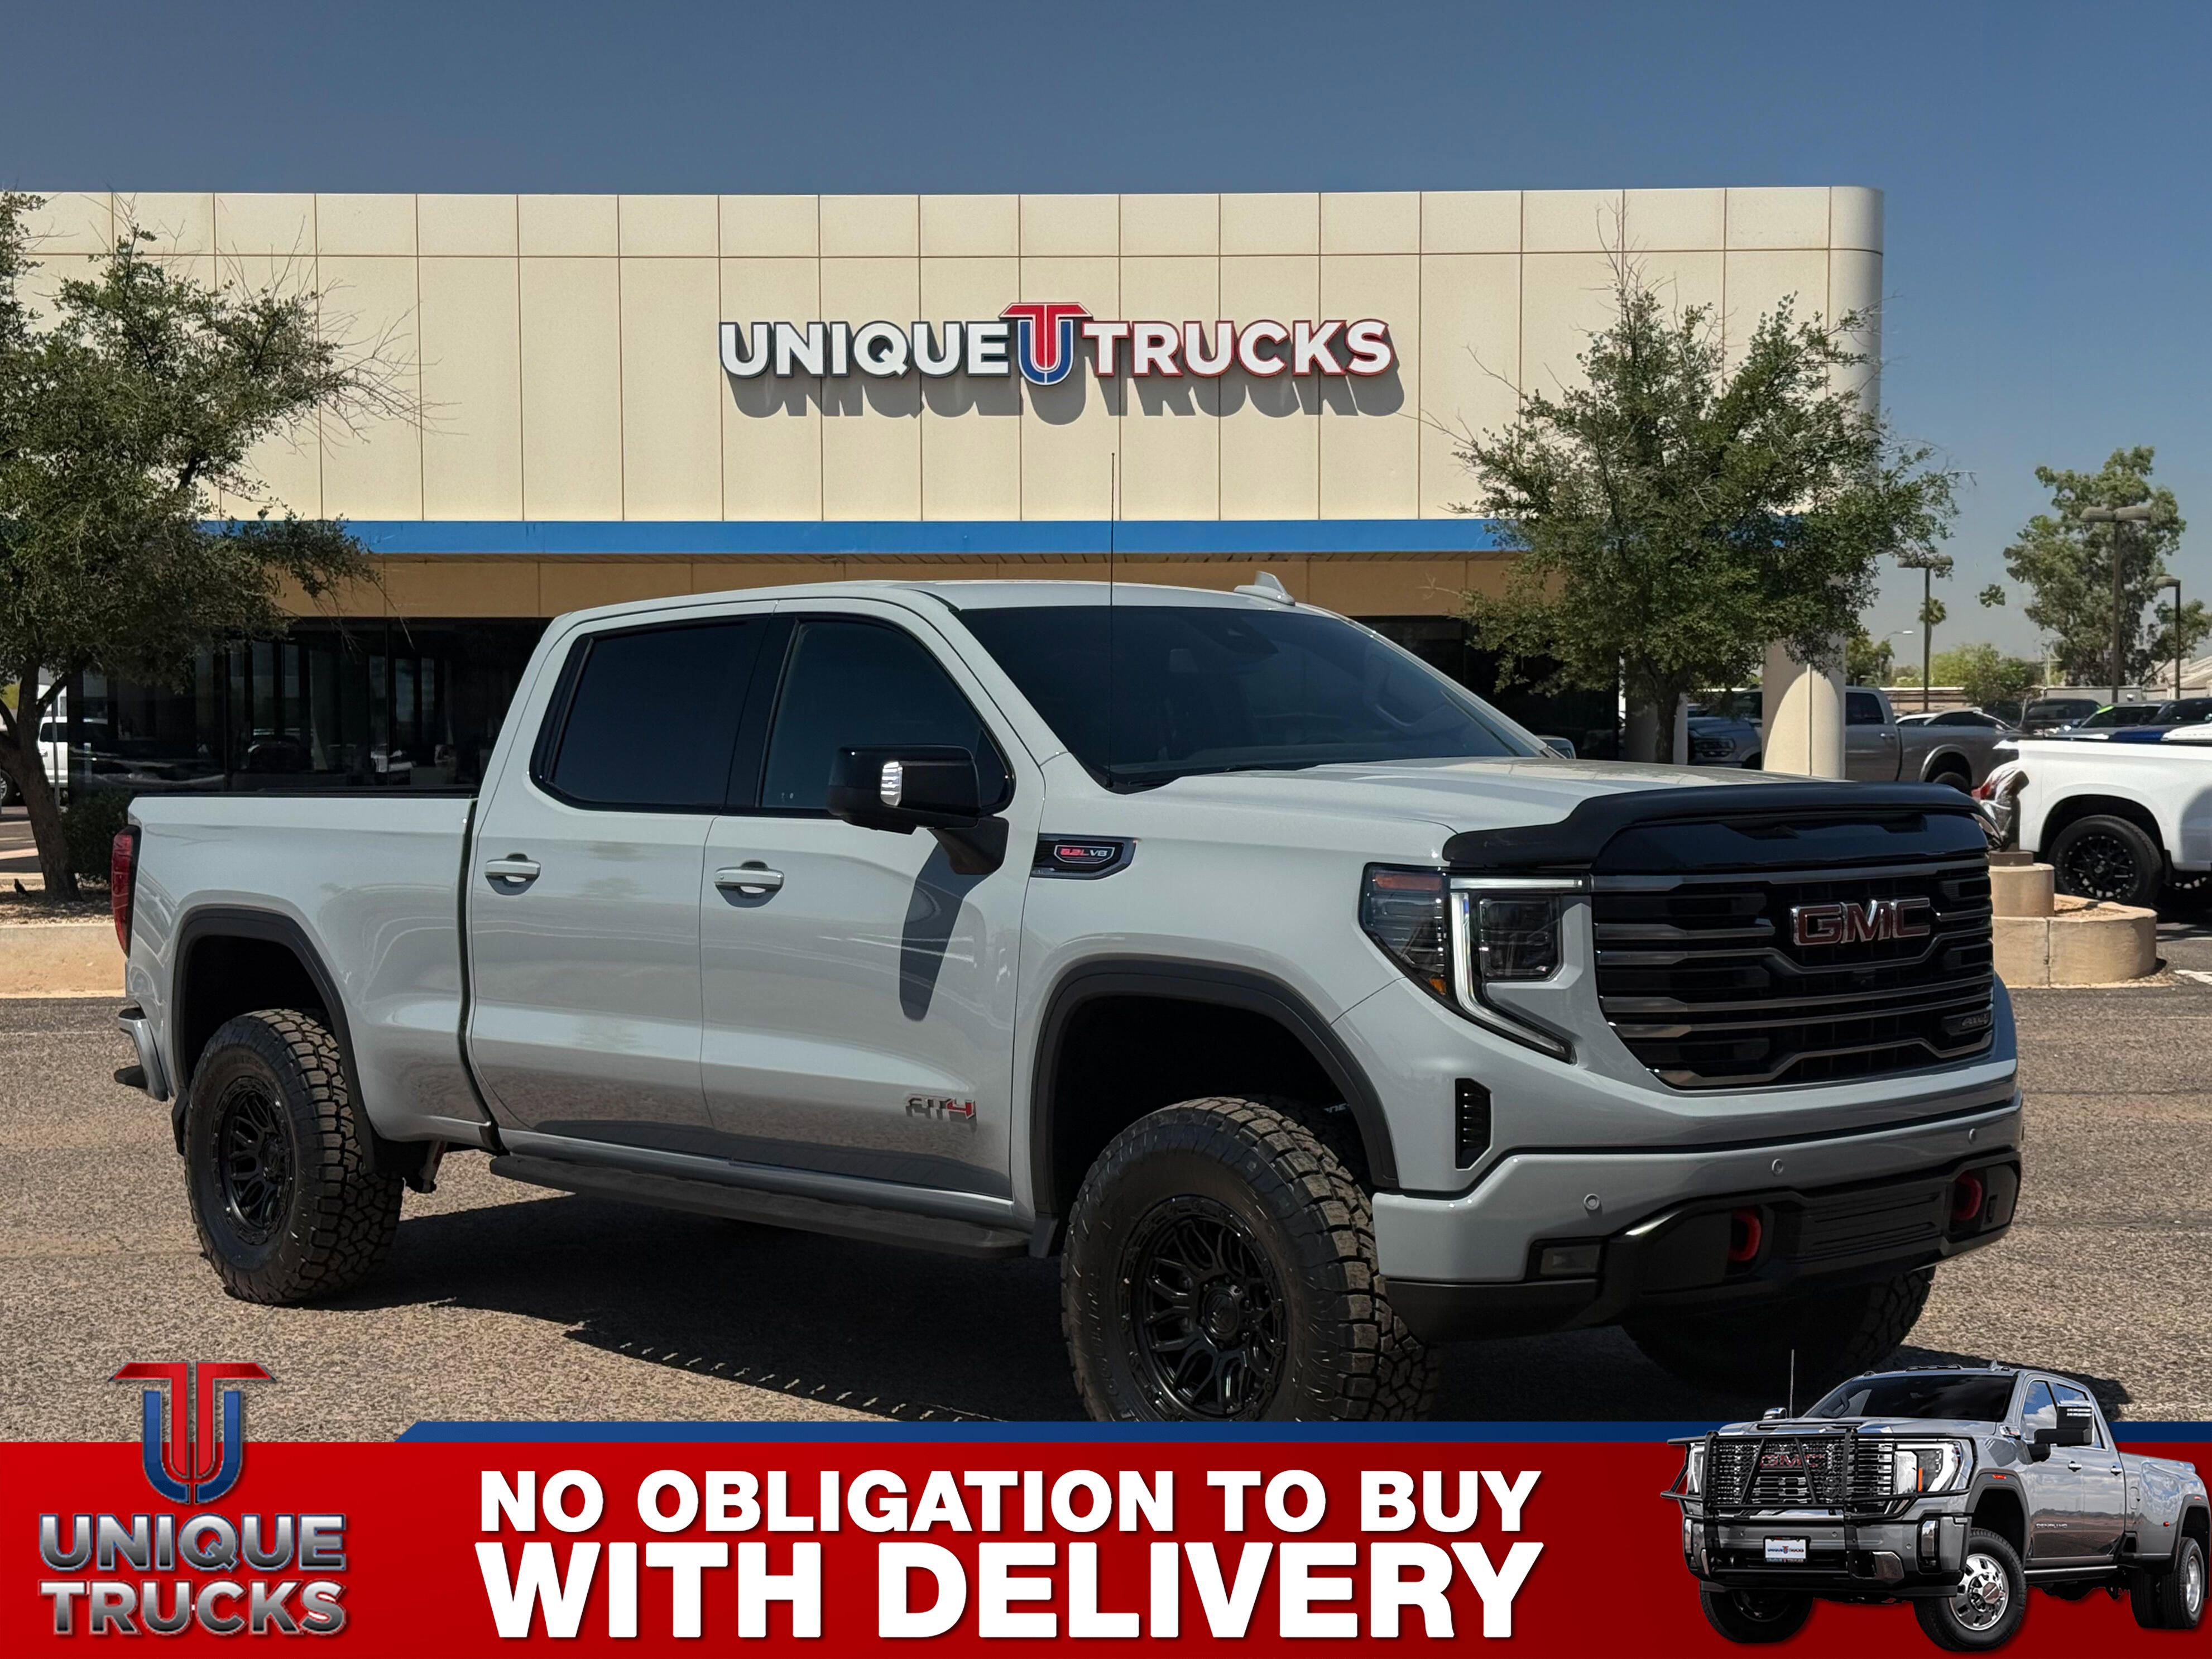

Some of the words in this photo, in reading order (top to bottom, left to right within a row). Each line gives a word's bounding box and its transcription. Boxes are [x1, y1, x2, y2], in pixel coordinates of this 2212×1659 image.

[719, 322, 1011, 377] UNIQUE
[1081, 320, 1394, 378] TRUCKS
[1790, 897, 1930, 946] GMC
[904, 1093, 976, 1120] AT4
